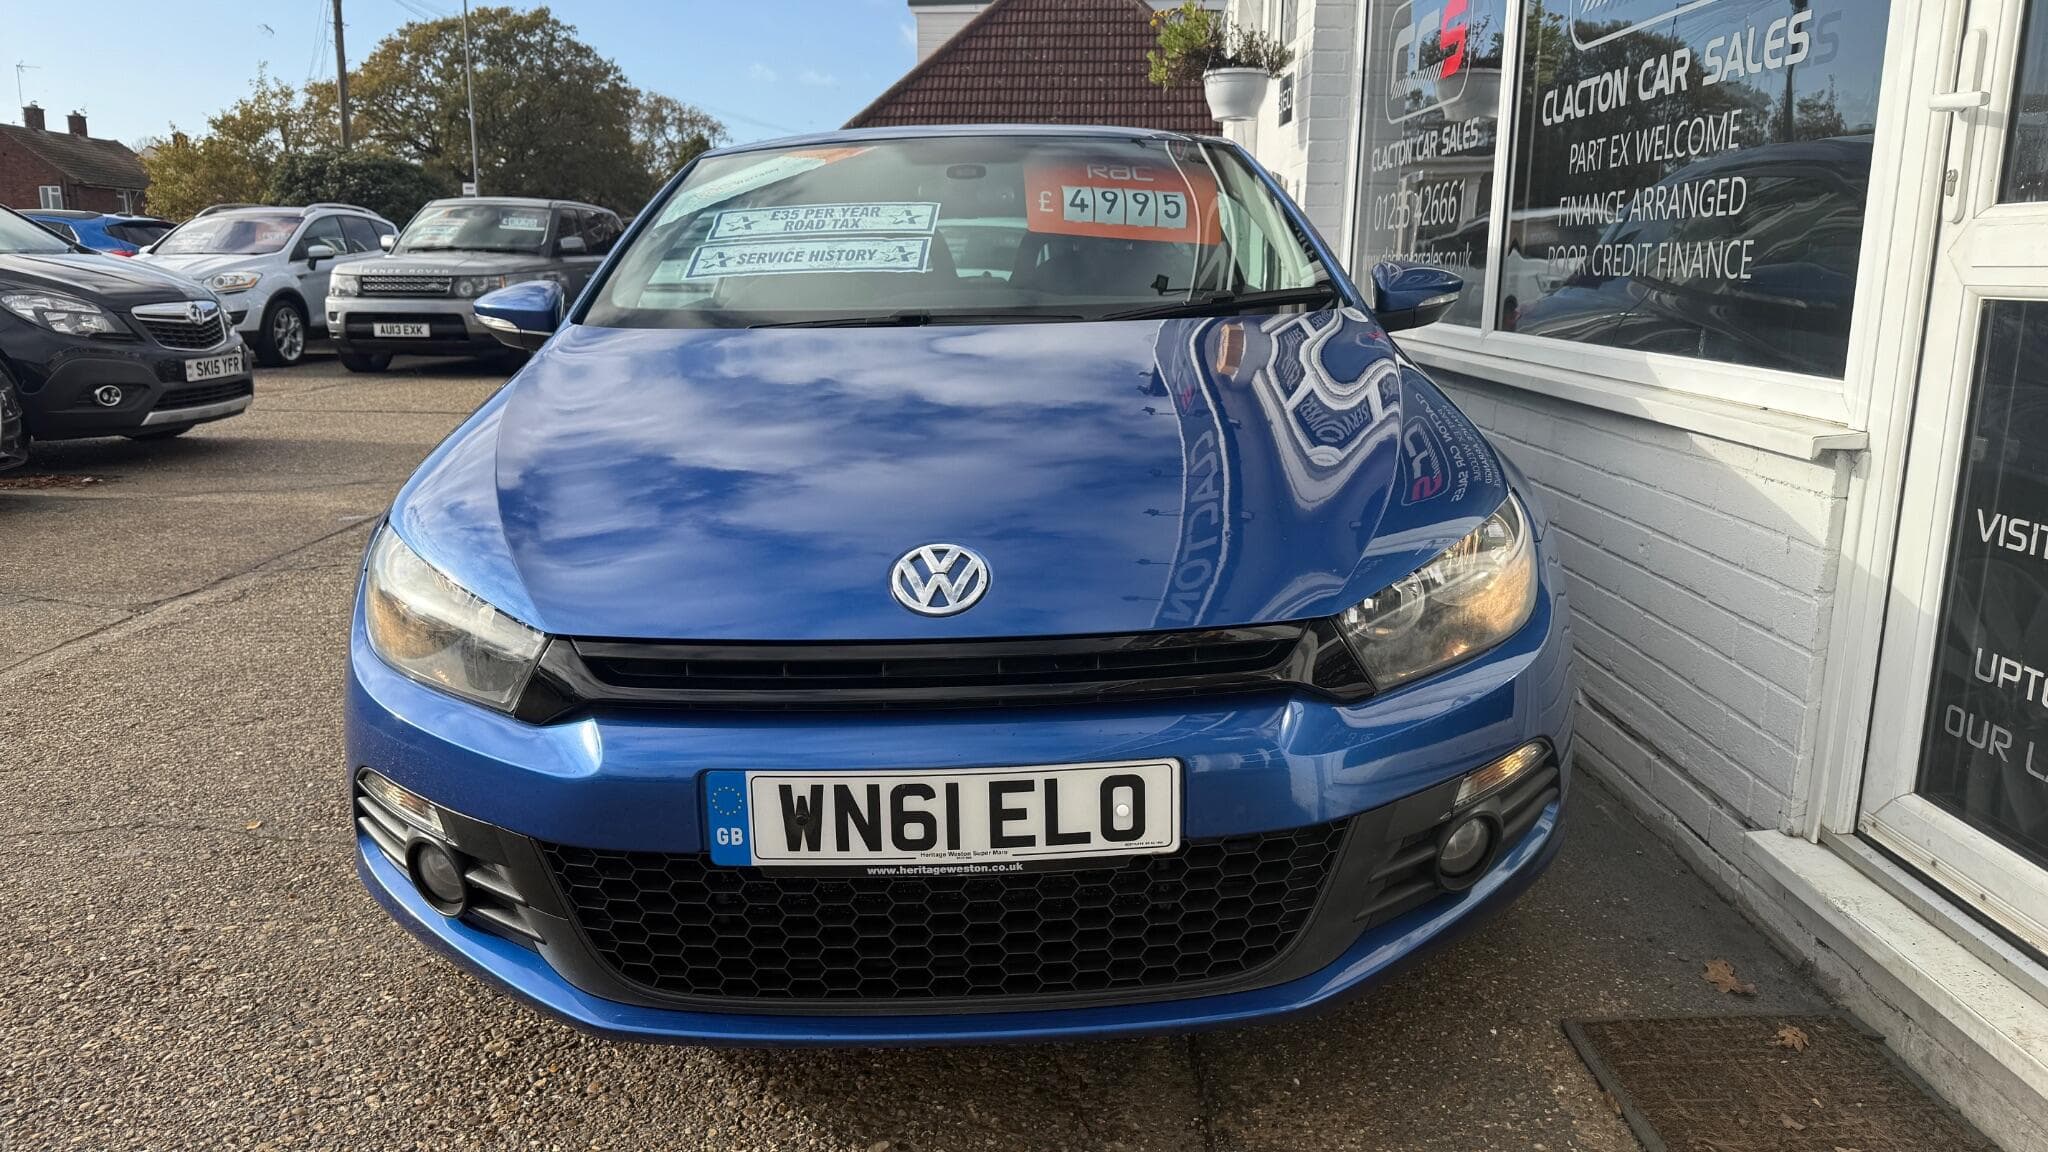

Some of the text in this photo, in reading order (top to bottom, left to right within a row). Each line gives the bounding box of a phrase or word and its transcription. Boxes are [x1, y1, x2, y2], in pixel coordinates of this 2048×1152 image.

[1542, 10, 1813, 126] CLACTON CAR SALES
[1372, 117, 1480, 172] CLACTON CAR SALES
[1569, 109, 1742, 175] PART EX WELCOME
[769, 206, 880, 222] £35 PER YEAR
[1069, 189, 1181, 219] 4995
[1558, 176, 1747, 227] FINANCE ARRANGED
[784, 218, 862, 231] ROAD TAX
[736, 249, 878, 265] SERVICE HISTORY
[1546, 239, 1755, 279] POOR CREDIT FINANCE
[196, 357, 239, 377] SK15 YFR
[1944, 704, 2048, 783] OUR L
[778, 774, 1146, 851] WN61 ELO
[716, 827, 744, 846] GB
[867, 862, 1023, 876] www.heritageweston.co.uk
